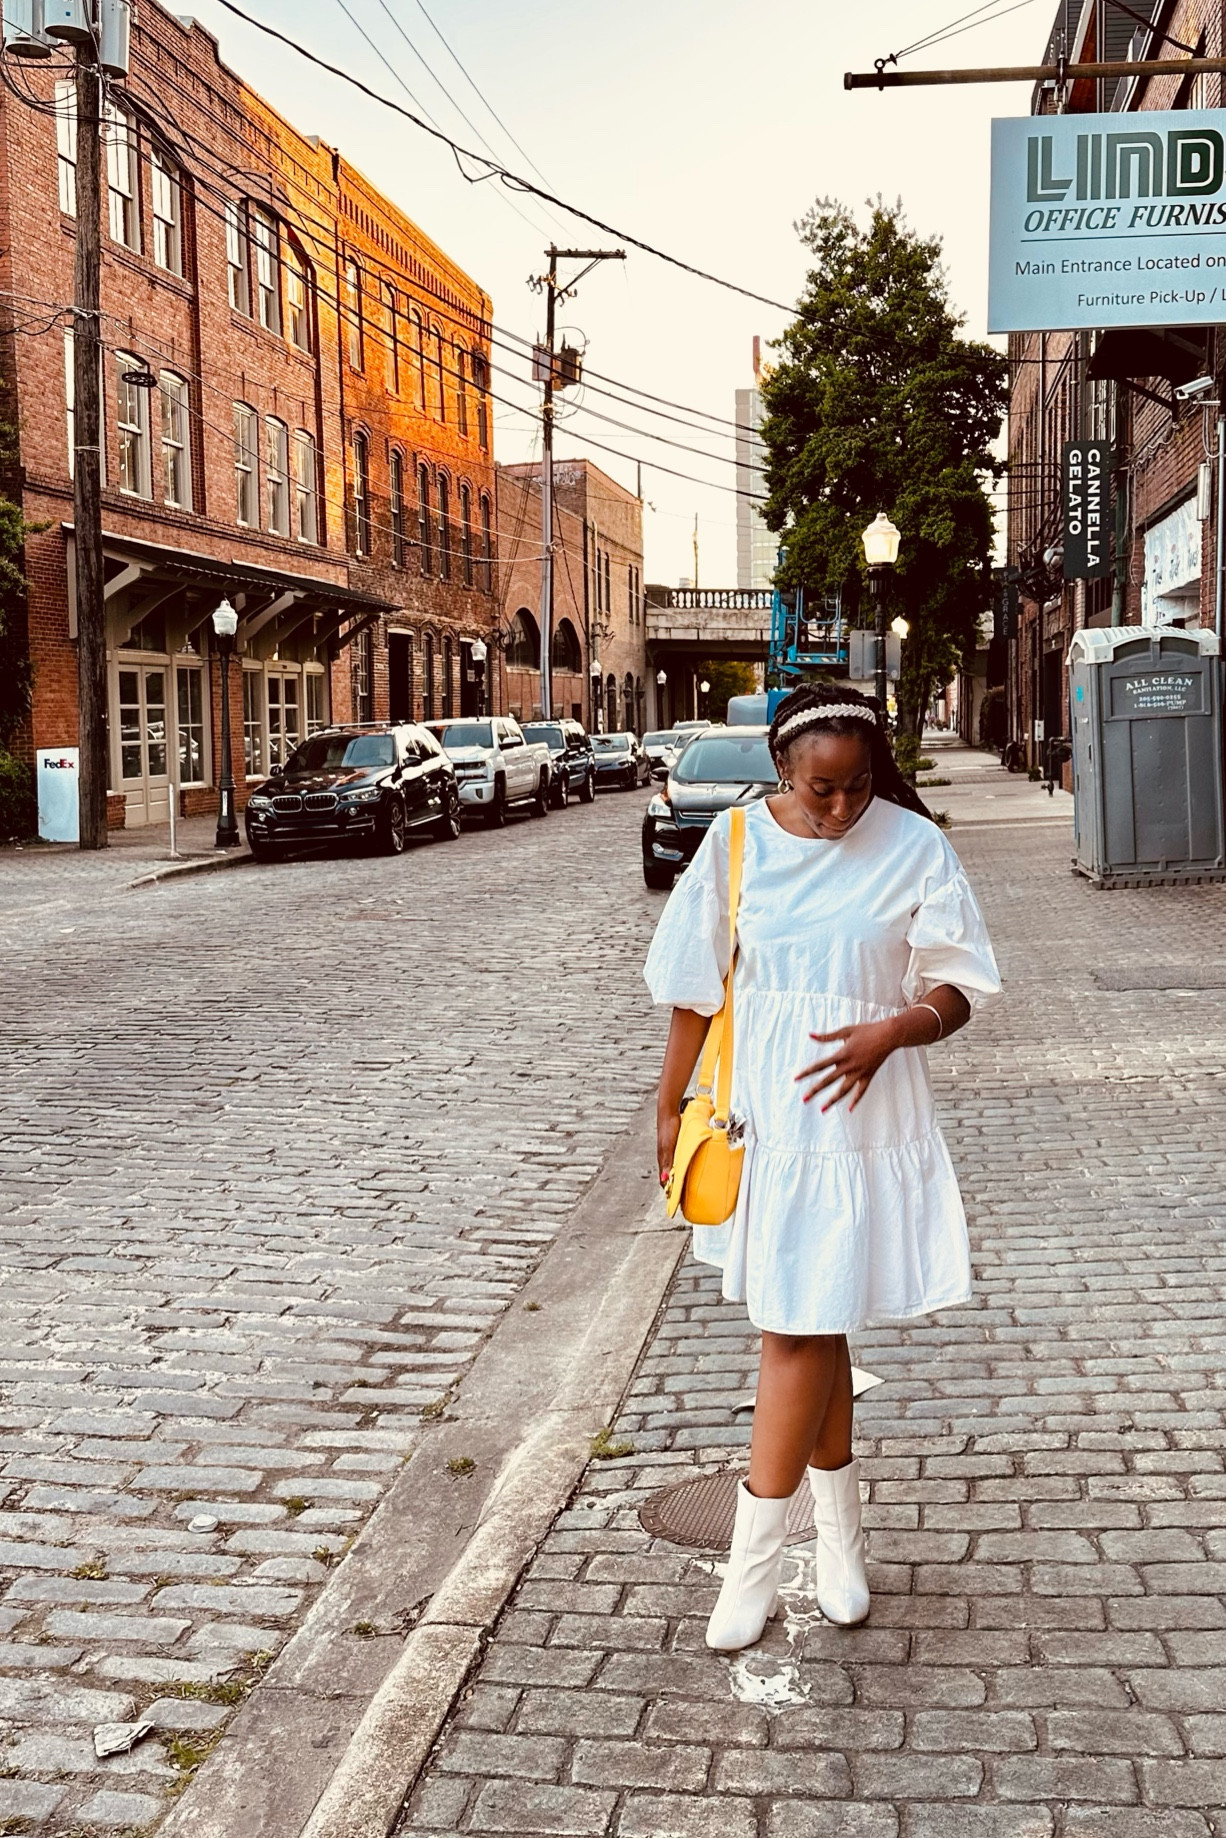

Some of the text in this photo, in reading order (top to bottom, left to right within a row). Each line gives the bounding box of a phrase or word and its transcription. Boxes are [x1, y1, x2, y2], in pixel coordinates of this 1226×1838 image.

[1024, 207, 1121, 232] OFFICE
[1015, 253, 1226, 275] Main Entrance Located on
[1078, 292, 1145, 307] Furniture
[1150, 289, 1206, 305] Pick-Up
[1209, 287, 1217, 304] /
[1069, 449, 1082, 535] GELATO
[1087, 449, 1100, 567] CANNELLA
[1126, 677, 1193, 690] ALL CLEAN
[44, 758, 75, 769] FedEx
